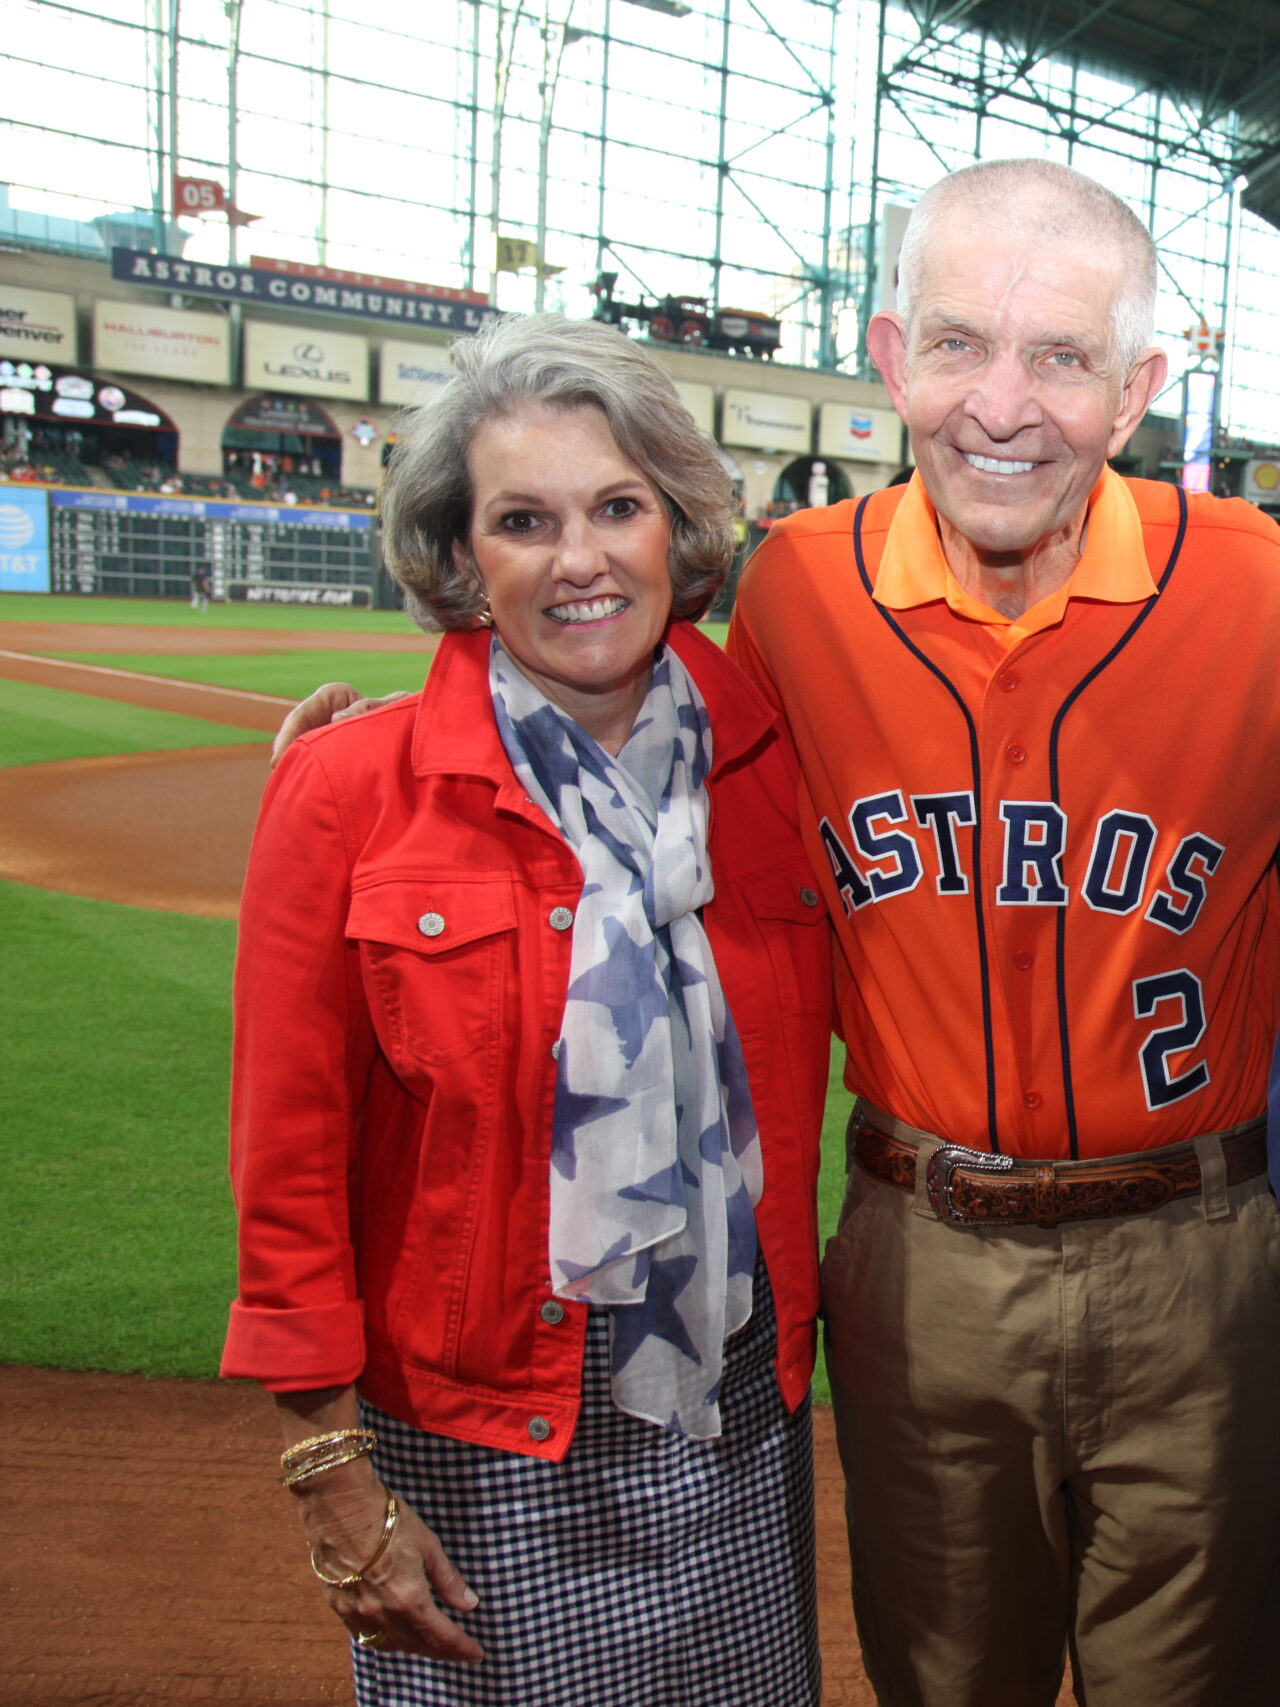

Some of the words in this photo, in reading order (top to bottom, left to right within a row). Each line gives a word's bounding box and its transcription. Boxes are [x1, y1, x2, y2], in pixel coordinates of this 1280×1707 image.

[183, 183, 217, 208] 05
[131, 257, 254, 294] ASTROS
[268, 278, 454, 324] COMMUNITY
[103, 321, 221, 346] HALLIBURTON
[263, 362, 353, 385] LEXUS
[819, 788, 1227, 936] ASTROS
[1131, 967, 1212, 1113] 2
